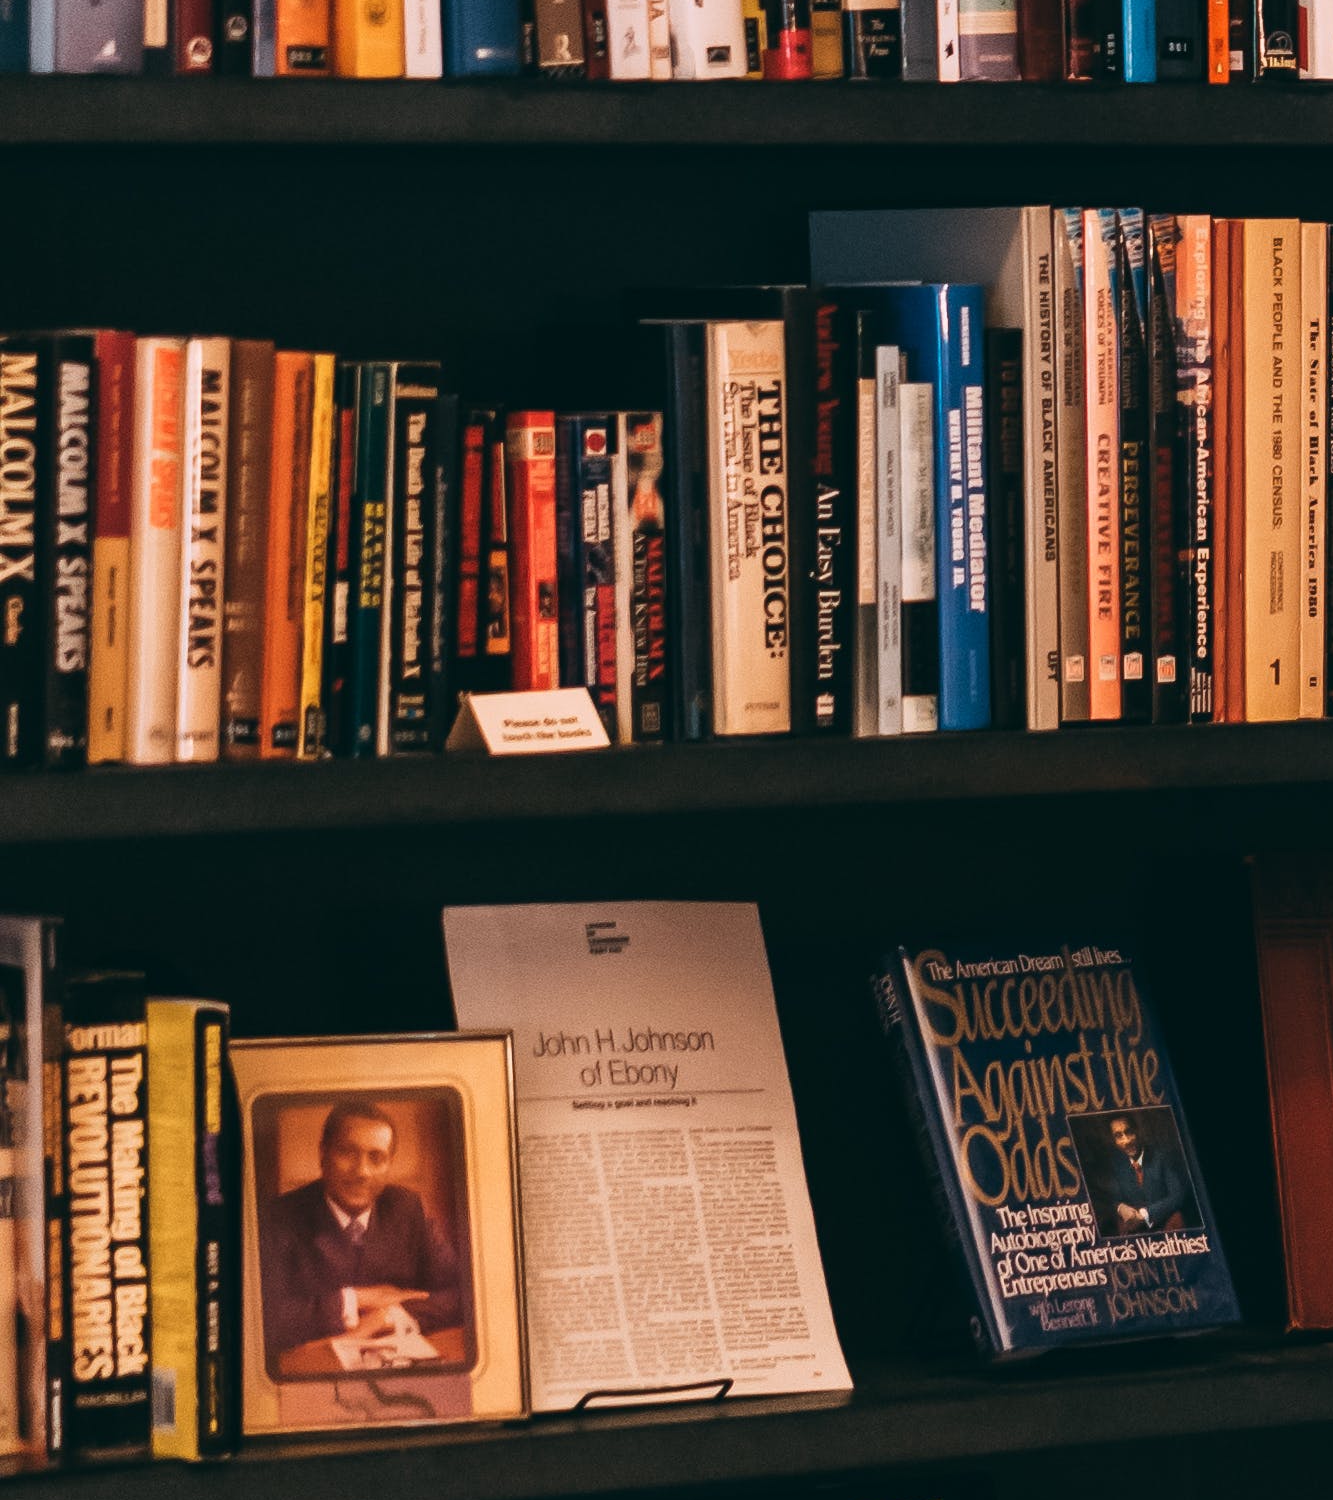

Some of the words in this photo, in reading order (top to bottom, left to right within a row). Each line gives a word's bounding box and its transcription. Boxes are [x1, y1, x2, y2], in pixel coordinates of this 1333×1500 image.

[758, 380, 784, 474] THE
[817, 483, 837, 519] An
[761, 482, 785, 659] CHOICE:
[811, 525, 839, 582] Easy
[817, 589, 839, 681] Burden
[917, 954, 1142, 1049] Succeeding
[580, 1060, 605, 1086] of
[609, 1060, 679, 1092] Ebony
[948, 1049, 1099, 1131] Against
[1104, 1041, 1164, 1107] the
[957, 1128, 1083, 1209] Odds
